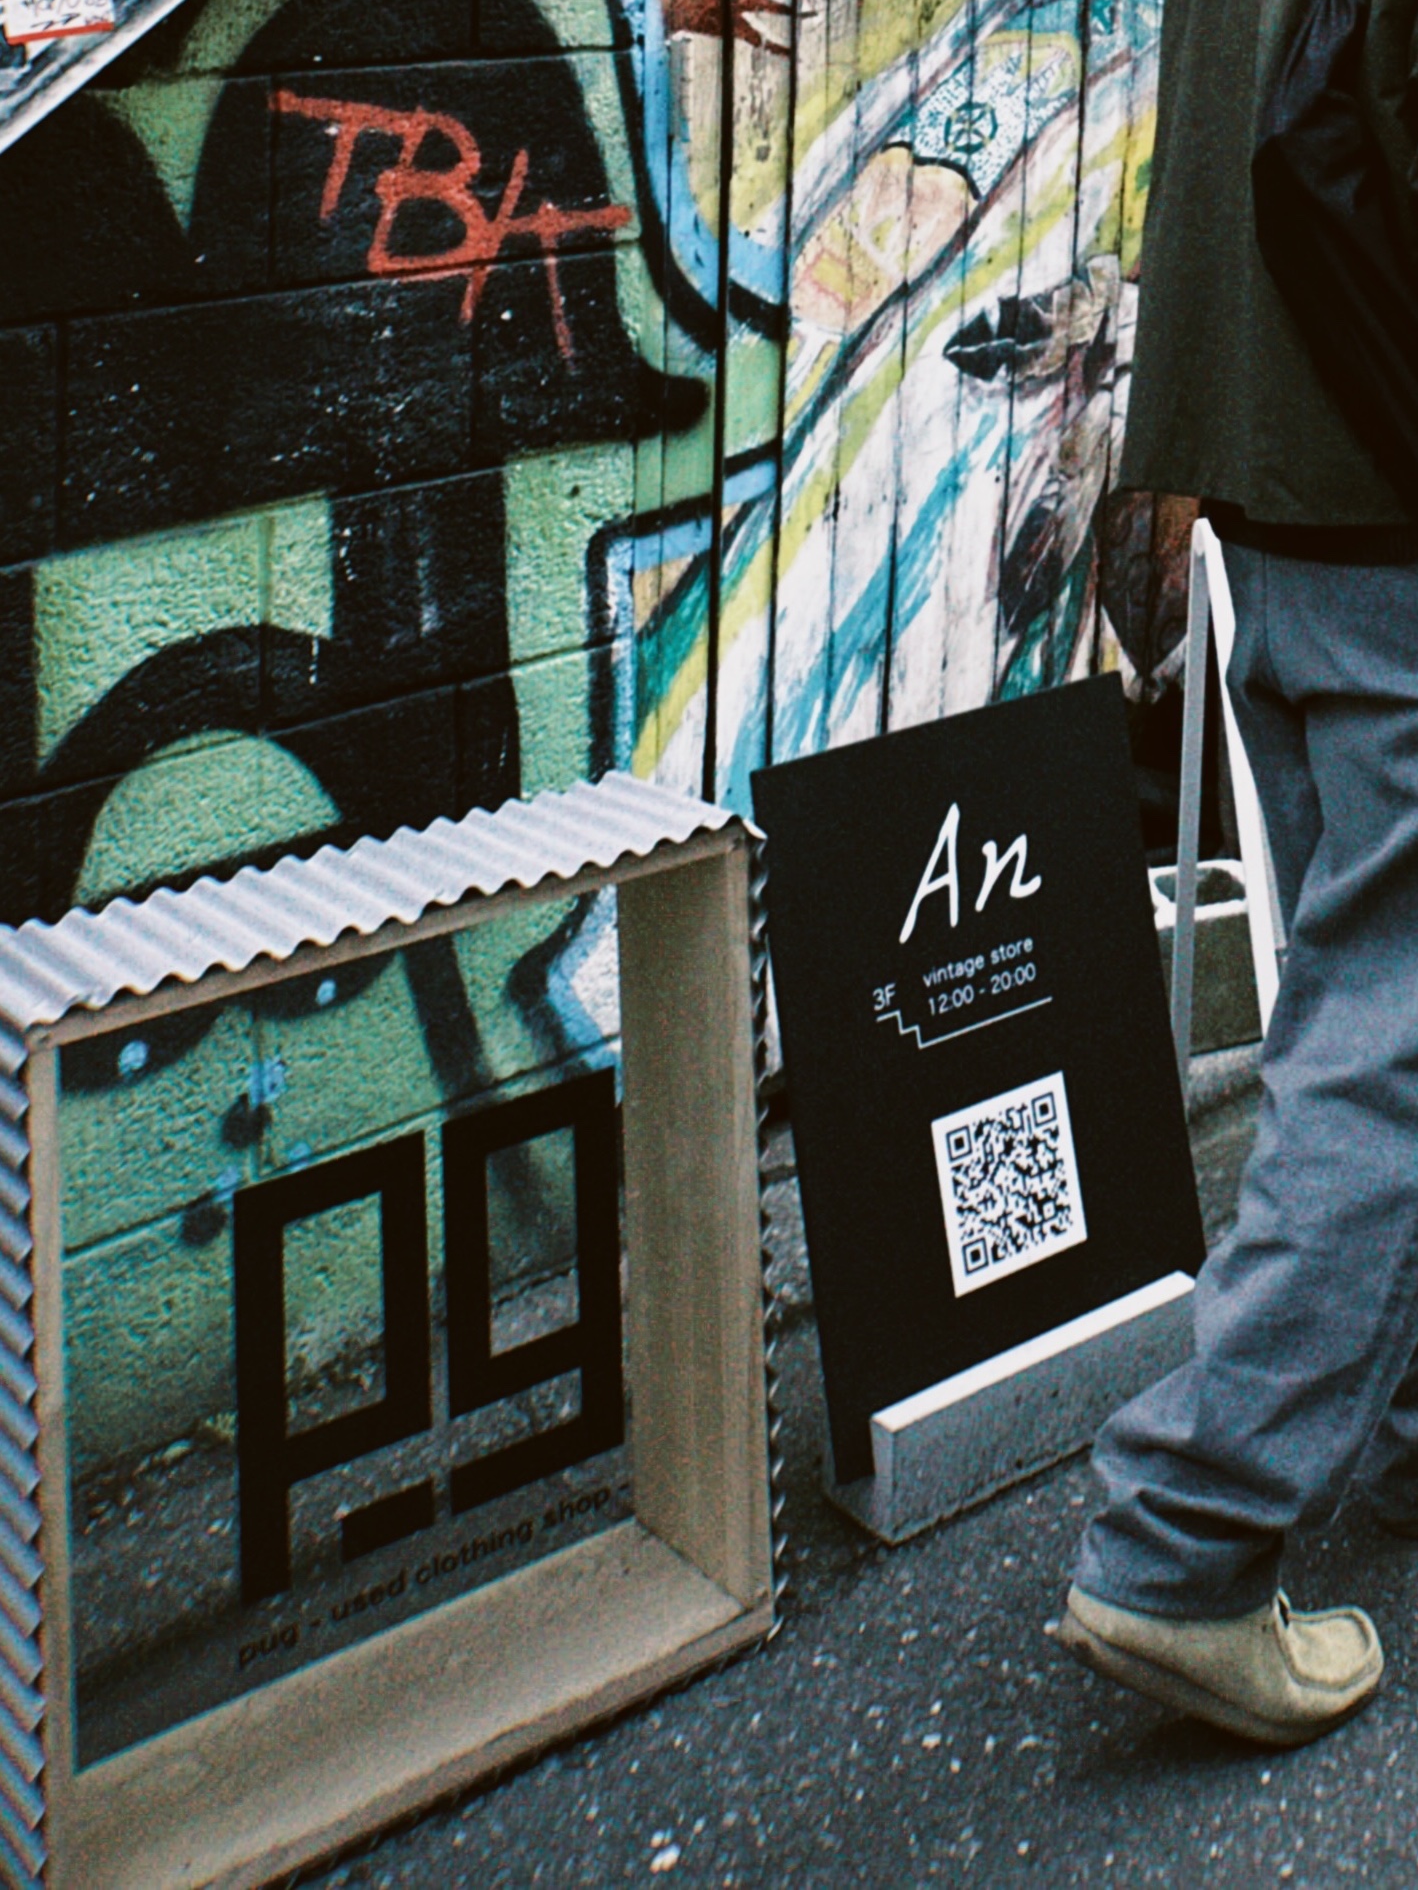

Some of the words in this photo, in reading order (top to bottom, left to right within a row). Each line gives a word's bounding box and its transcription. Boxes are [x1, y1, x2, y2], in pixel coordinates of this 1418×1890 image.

[898, 801, 1043, 945] An
[922, 954, 986, 989] vintage
[990, 937, 1035, 966] store
[928, 984, 976, 1016] 12:00
[989, 962, 1038, 995] 20:00
[872, 982, 897, 1012] 3F
[238, 1621, 302, 1669] pug
[331, 1569, 408, 1622] used
[415, 1514, 534, 1588] clothing
[541, 1485, 612, 1532] shop
